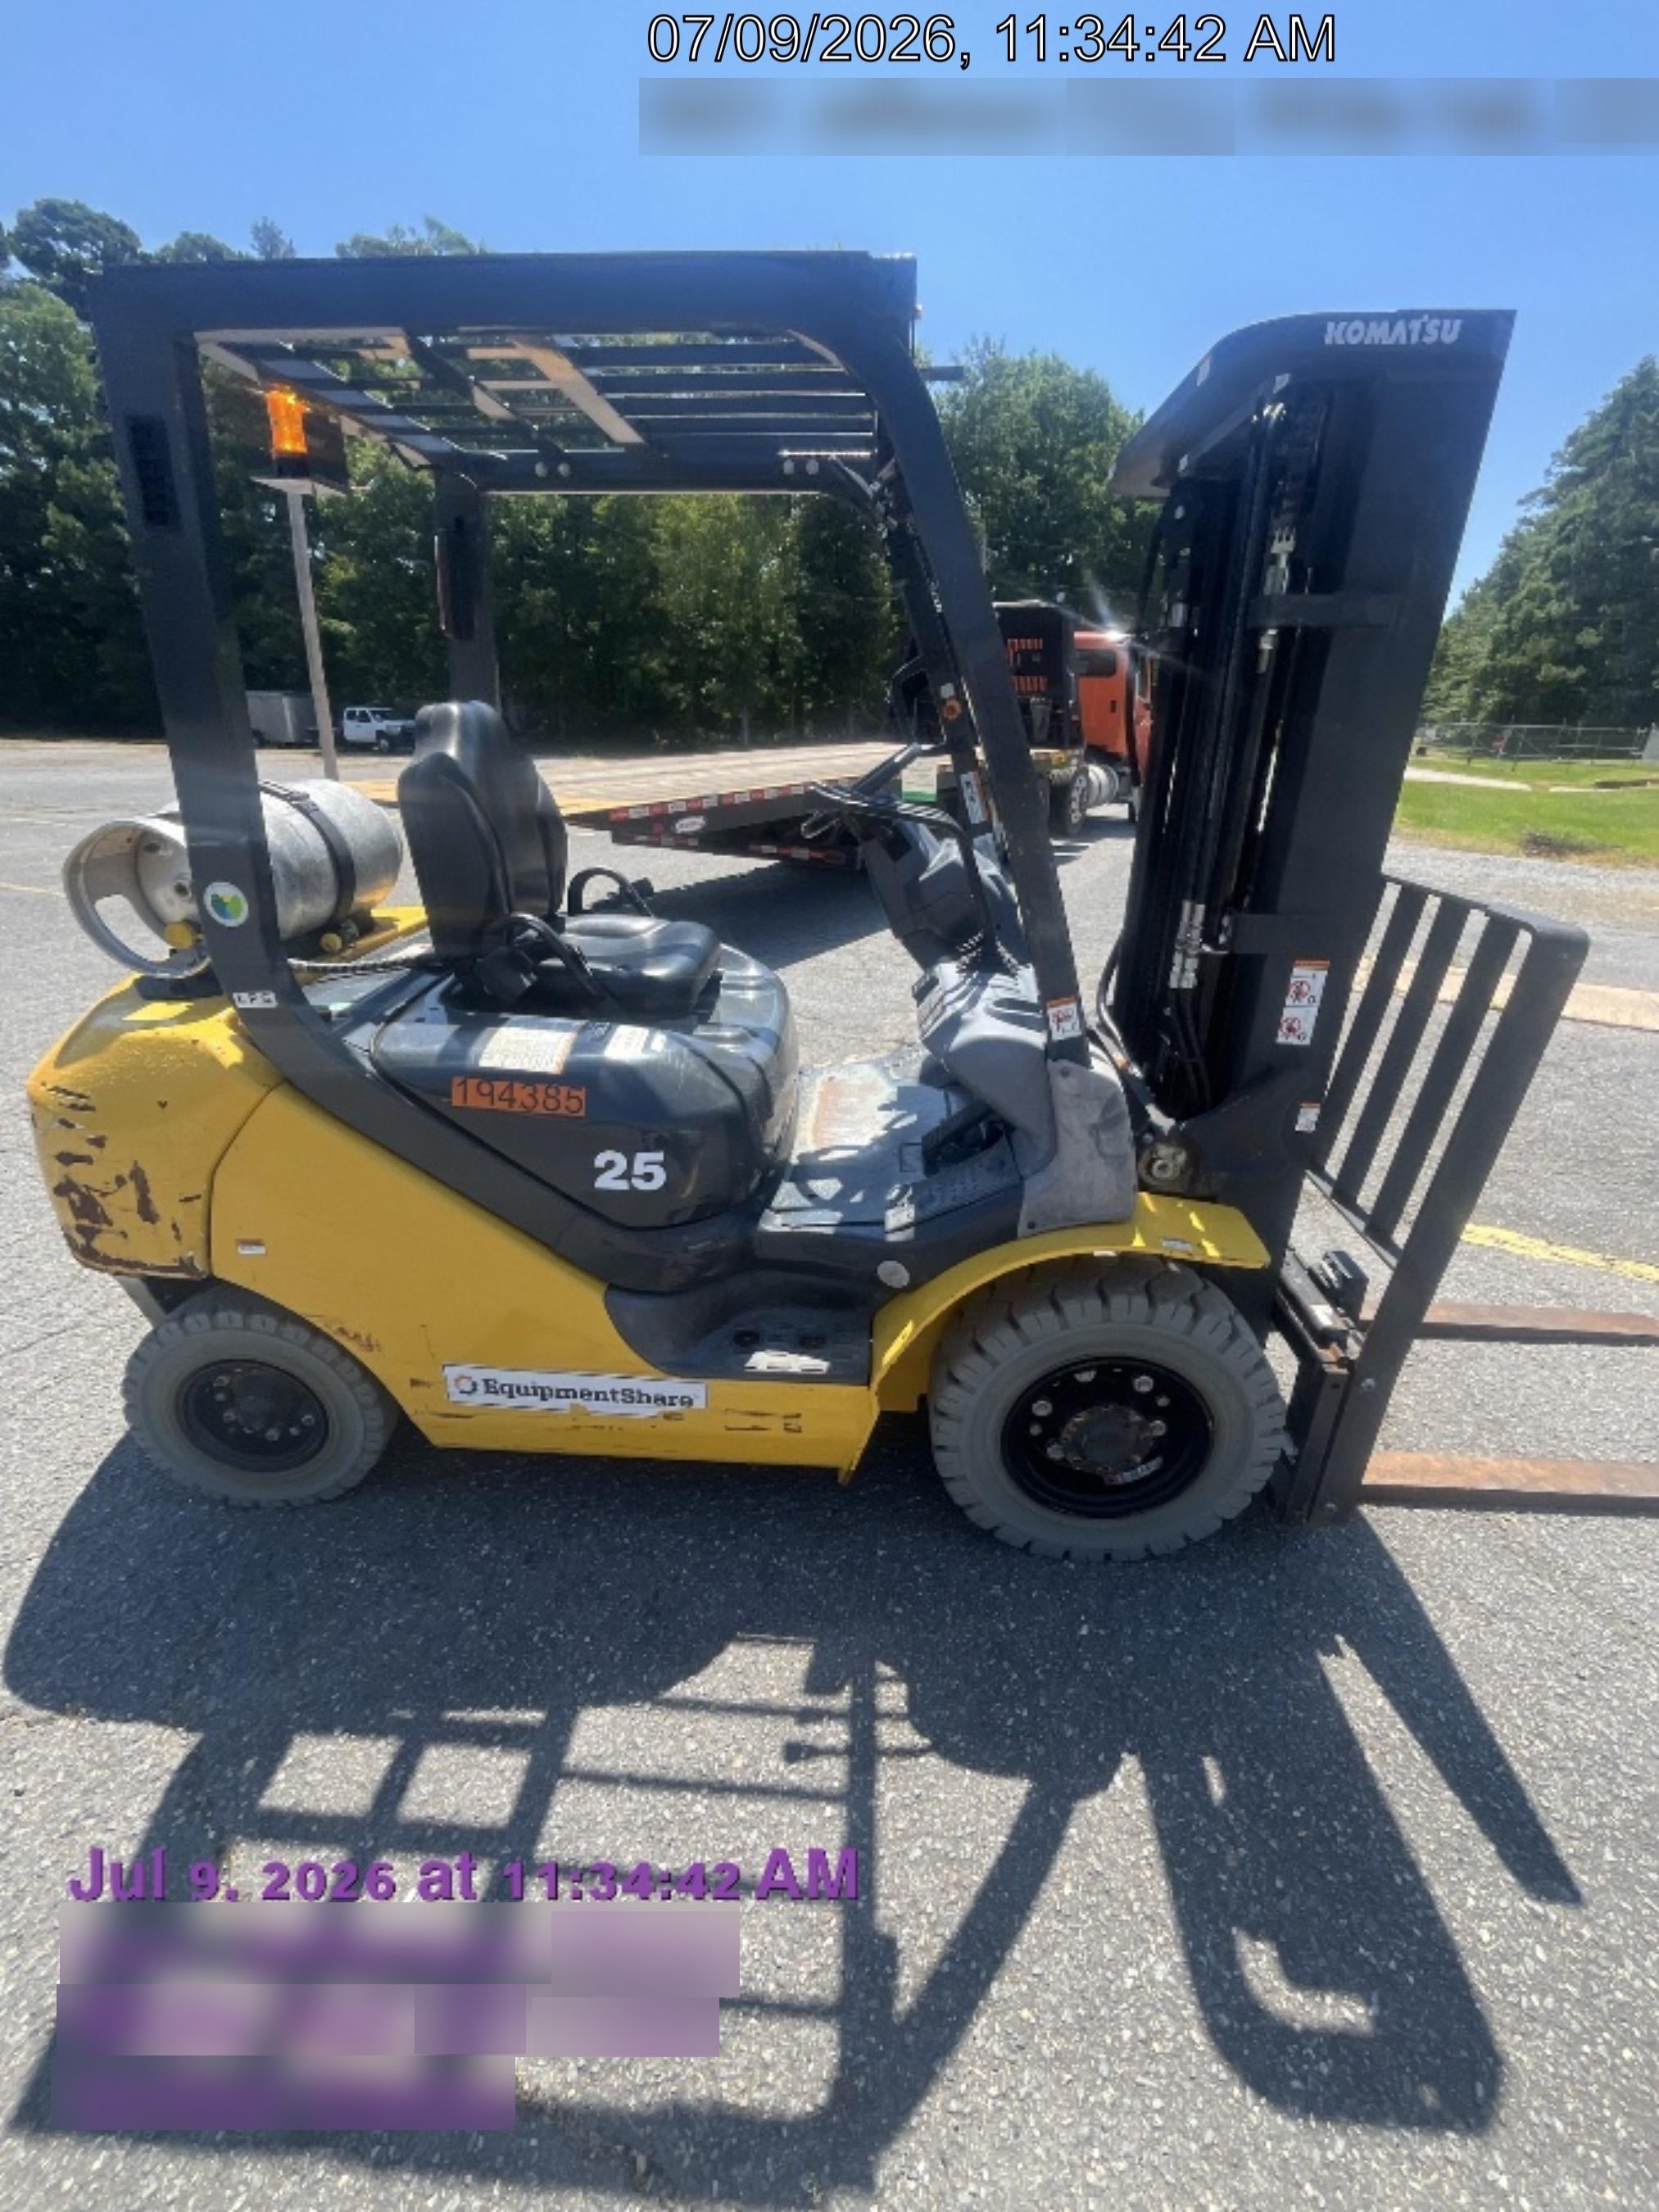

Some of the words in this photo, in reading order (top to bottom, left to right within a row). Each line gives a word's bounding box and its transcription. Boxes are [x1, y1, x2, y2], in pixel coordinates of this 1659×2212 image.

[1324, 315, 1462, 345] KOMATSU
[456, 1077, 584, 1115] 194385
[593, 1149, 667, 1190] 25
[482, 1378, 696, 1407] EquipmentShare
